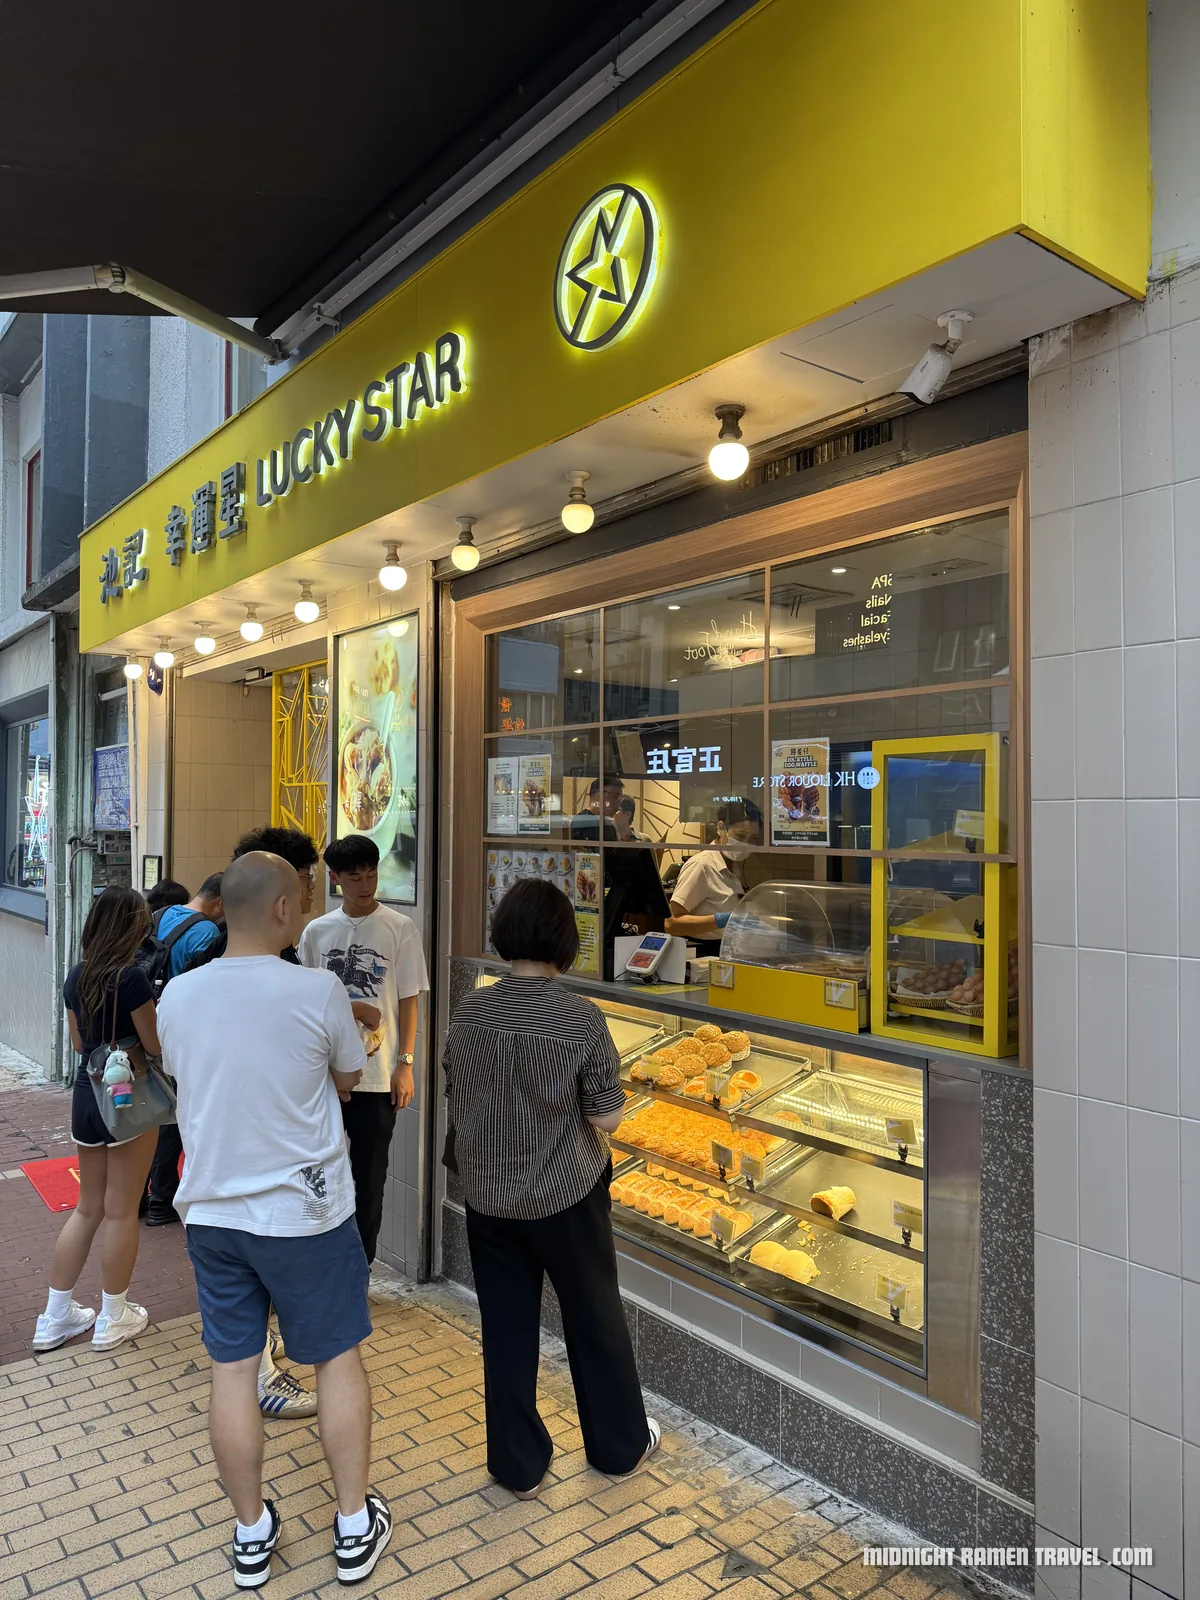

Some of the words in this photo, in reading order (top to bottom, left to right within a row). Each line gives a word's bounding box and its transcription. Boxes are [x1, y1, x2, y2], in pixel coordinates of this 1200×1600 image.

[163, 462, 248, 568] 幸運星
[256, 398, 360, 508] LUCKY
[361, 331, 468, 443] STAR
[342, 1538, 356, 1547] NIKE
[246, 1544, 260, 1553] NIKE
